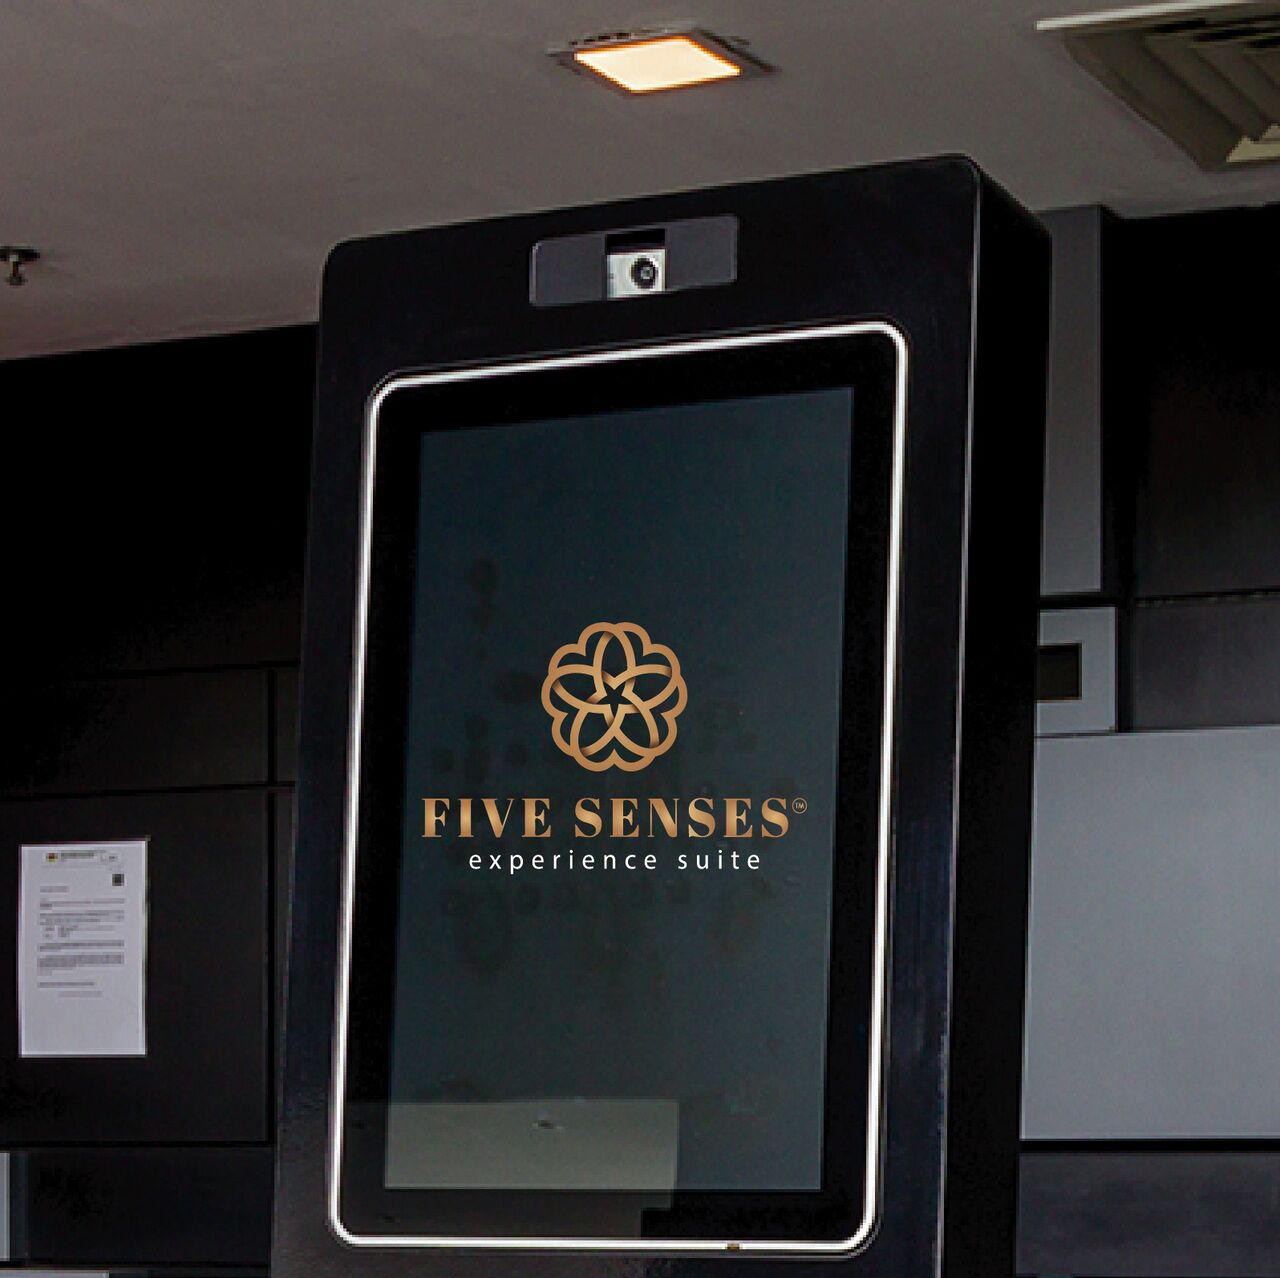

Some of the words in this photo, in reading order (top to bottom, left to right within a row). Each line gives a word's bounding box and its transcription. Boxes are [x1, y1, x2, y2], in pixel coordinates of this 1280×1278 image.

[421, 797, 552, 838] FIVE
[574, 797, 790, 839] SENSES
[468, 849, 658, 874] experience
[677, 849, 761, 870] suite
